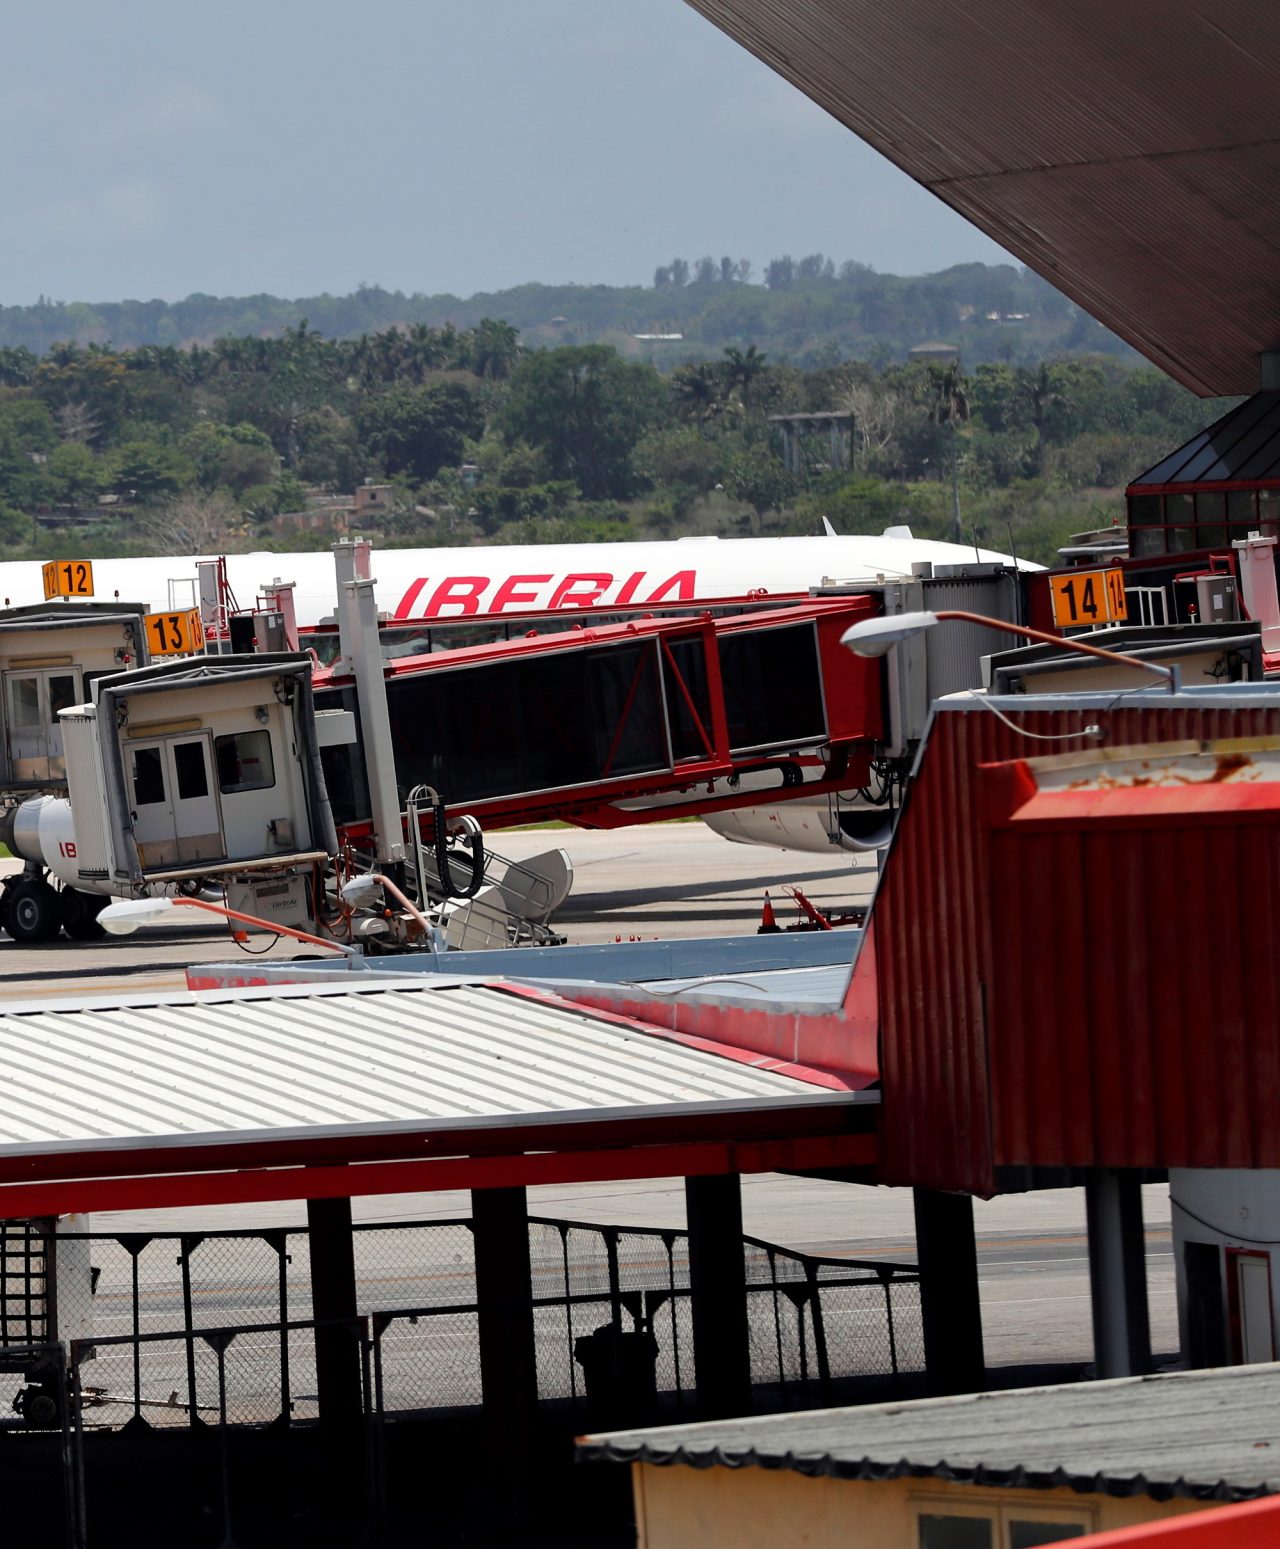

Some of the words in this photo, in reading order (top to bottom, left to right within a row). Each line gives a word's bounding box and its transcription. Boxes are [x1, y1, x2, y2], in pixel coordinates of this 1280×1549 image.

[45, 566, 56, 595] 12
[63, 564, 88, 593] 12
[1110, 574, 1123, 616] 14
[1061, 578, 1097, 620] 14
[153, 616, 183, 651] 13
